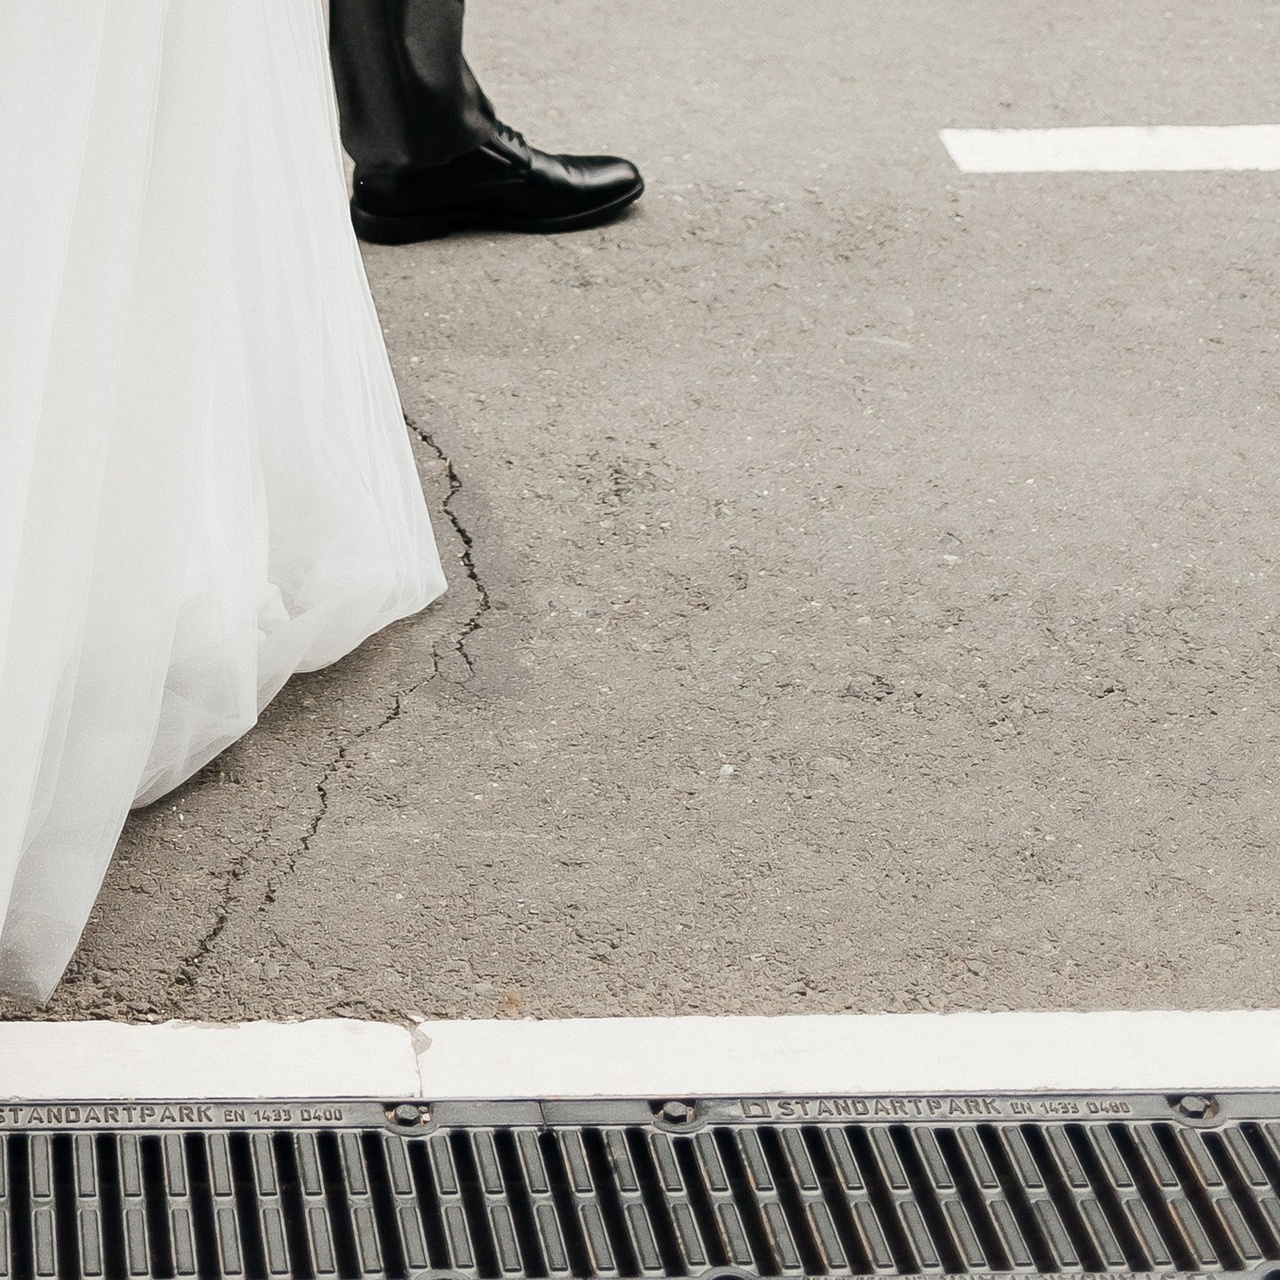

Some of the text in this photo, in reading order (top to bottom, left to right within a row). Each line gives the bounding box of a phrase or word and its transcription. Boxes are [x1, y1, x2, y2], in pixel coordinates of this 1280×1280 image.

[776, 1097, 1002, 1117] STANDARTPARK
[223, 1109, 246, 1123] EN
[253, 1109, 293, 1122] 1433
